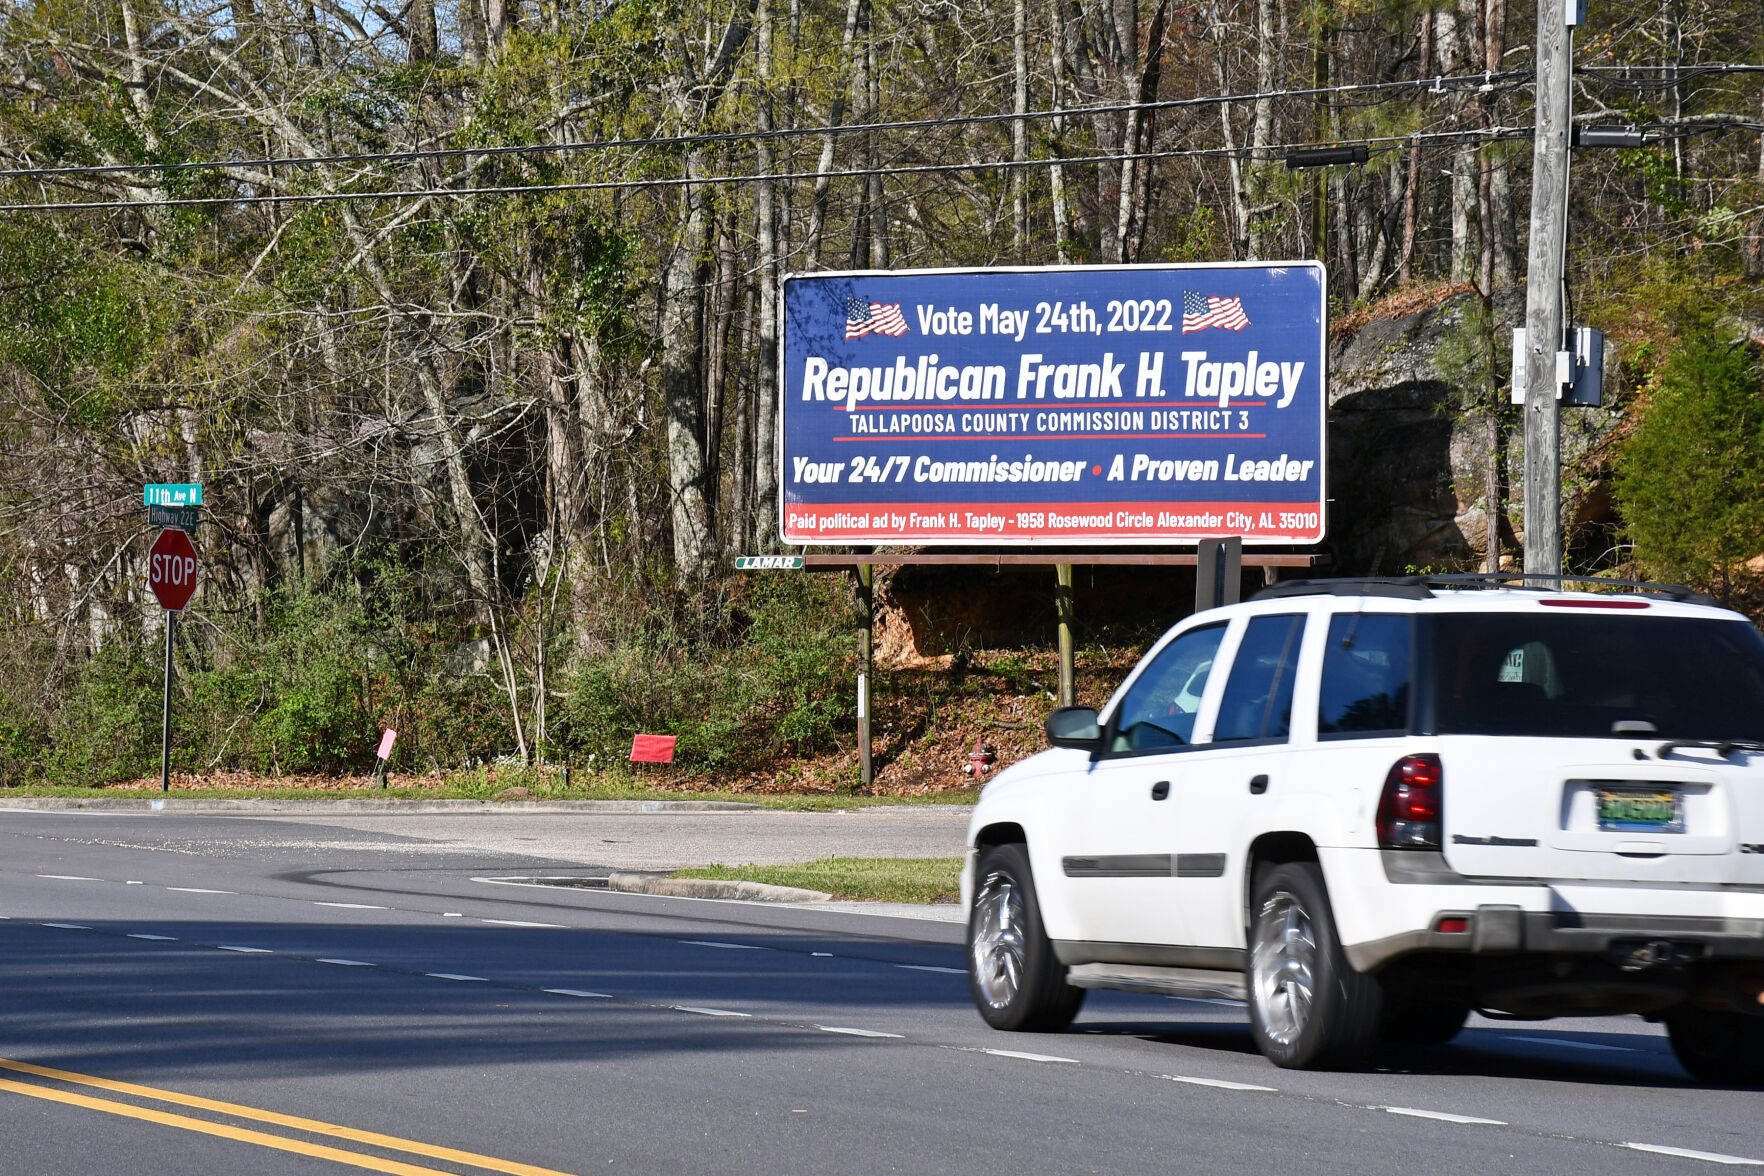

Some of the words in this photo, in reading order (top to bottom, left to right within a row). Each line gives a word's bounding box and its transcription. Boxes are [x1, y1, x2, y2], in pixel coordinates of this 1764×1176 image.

[917, 304, 972, 335] Vote
[979, 303, 1029, 342] May
[1035, 301, 1102, 335] 24th,
[1107, 299, 1173, 332] 2022
[802, 353, 1006, 412] Republican
[1017, 352, 1125, 399] Frank
[1136, 351, 1166, 397] H.
[1181, 350, 1305, 409] Tapley
[850, 414, 955, 433] TALLAPOOSA
[962, 412, 1029, 432] COUNTY
[1036, 411, 1144, 431] COMMISSION
[1151, 410, 1232, 430] DISTRICT
[1238, 410, 1249, 430] 3
[793, 456, 845, 483] Your
[848, 456, 911, 483] 24/7
[914, 454, 1087, 482] Commissioner
[1107, 454, 1125, 482] A
[1131, 454, 1219, 482] Proven
[1224, 453, 1314, 482] Leader
[149, 488, 171, 503] 11th
[174, 490, 186, 501] Ave
[189, 488, 197, 503] N
[151, 508, 179, 525] Highway
[180, 511, 194, 526] 22E
[789, 513, 817, 529] Paid
[819, 512, 870, 532] political
[872, 512, 888, 529] ad
[891, 512, 907, 532] by
[909, 512, 946, 529] Frank
[949, 512, 962, 529] H.
[965, 512, 1005, 532] Tapley
[1048, 512, 1113, 529] Rosewood
[1116, 512, 1154, 528] Circle
[1157, 511, 1223, 528] Alexander
[1227, 511, 1255, 532] City,
[1258, 513, 1276, 529] AL
[1279, 512, 1318, 529] 35010
[152, 553, 195, 586] STOP
[743, 557, 795, 568] LAMAR
